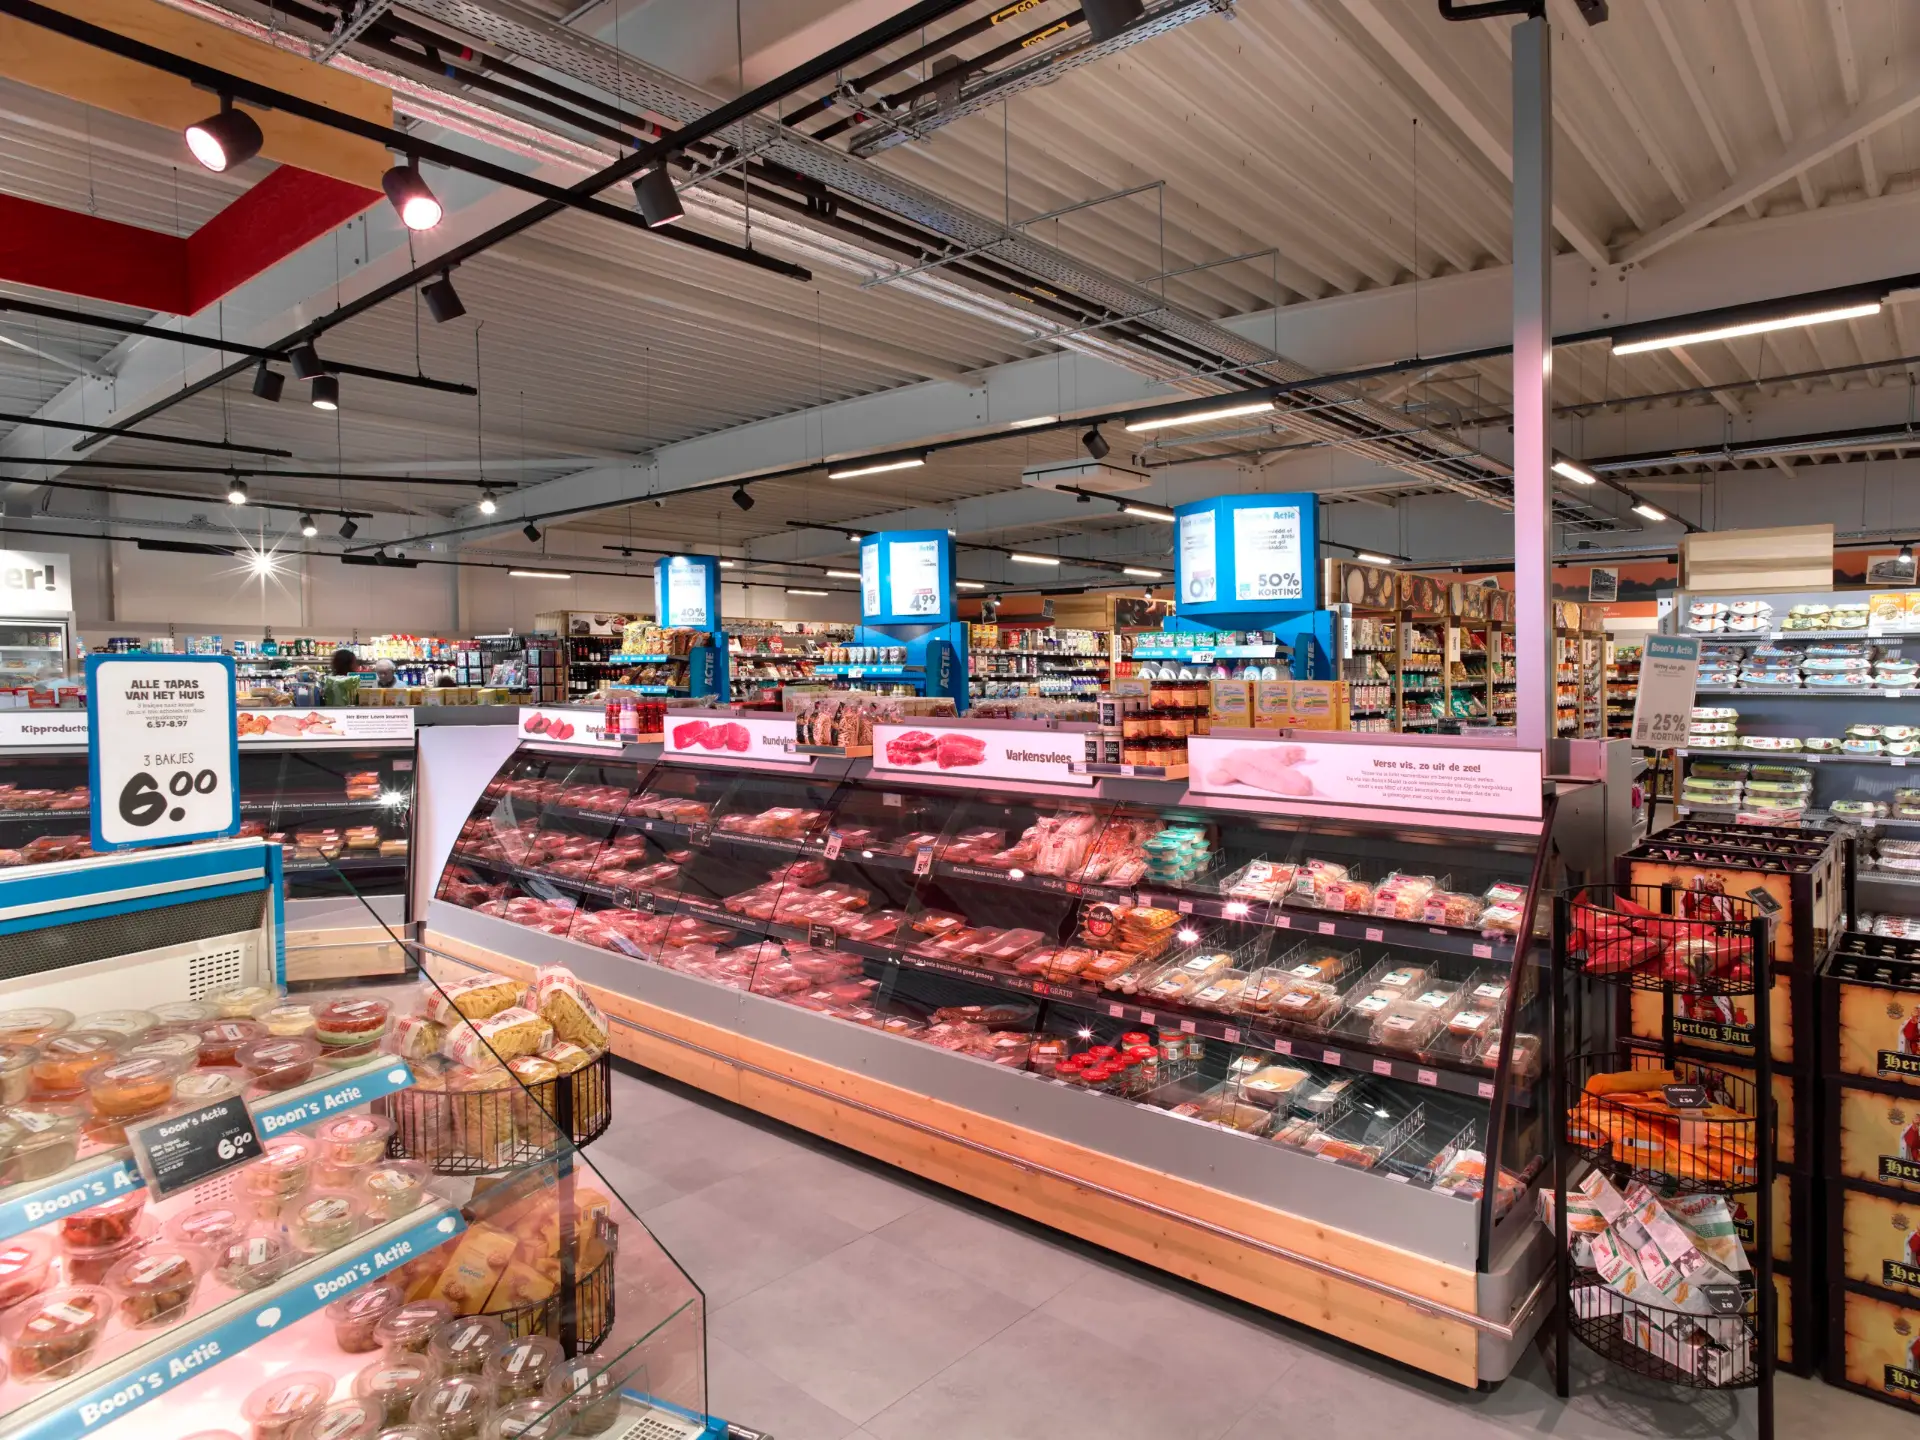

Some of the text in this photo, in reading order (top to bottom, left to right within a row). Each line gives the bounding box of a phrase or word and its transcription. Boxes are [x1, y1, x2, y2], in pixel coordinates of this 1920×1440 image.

[1258, 573, 1300, 587] 50%
[1258, 587, 1300, 596] KORTING
[681, 608, 705, 617] 40%
[1651, 643, 1693, 655] Boon's Actie
[940, 647, 950, 688] ACTIE
[1307, 641, 1315, 680] CTIE
[705, 652, 714, 686] ACTIE
[131, 680, 199, 689] ALLE TAPAS
[125, 691, 205, 700] VAN HET HUIS
[21, 724, 88, 735] Kipproducte
[147, 720, 188, 728] 6.57-8.97
[586, 725, 605, 733] Rundvle
[1652, 713, 1686, 732] 25%
[1651, 732, 1685, 742] KORTING
[143, 753, 194, 766] 3 BAKJES
[1006, 749, 1071, 763] Varkensvlees
[1373, 759, 1397, 768] Verse
[1433, 763, 1445, 771] uit
[1449, 763, 1460, 771] de
[1463, 765, 1481, 773] zee!
[118, 769, 218, 827] 6.00
[1082, 887, 1104, 896] GRATIS
[1094, 922, 1106, 931] 3+1
[936, 962, 957, 972] kwaliteit
[975, 971, 995, 981] genoeg.
[1050, 987, 1073, 998] GRATIS
[1673, 1019, 1750, 1043] Hertog Jan
[1884, 1053, 1920, 1071] Her
[262, 1087, 362, 1133] Boon's Actie
[160, 1107, 228, 1137] Boon's Actie
[150, 1145, 162, 1153] Alle
[218, 1132, 252, 1159] 6.00
[1885, 1159, 1920, 1178] Her
[23, 1169, 141, 1221] Boon's Ac
[313, 1241, 412, 1300] Boon's Actie
[1890, 1263, 1920, 1283] He
[78, 1341, 222, 1427] Boon's Actie
